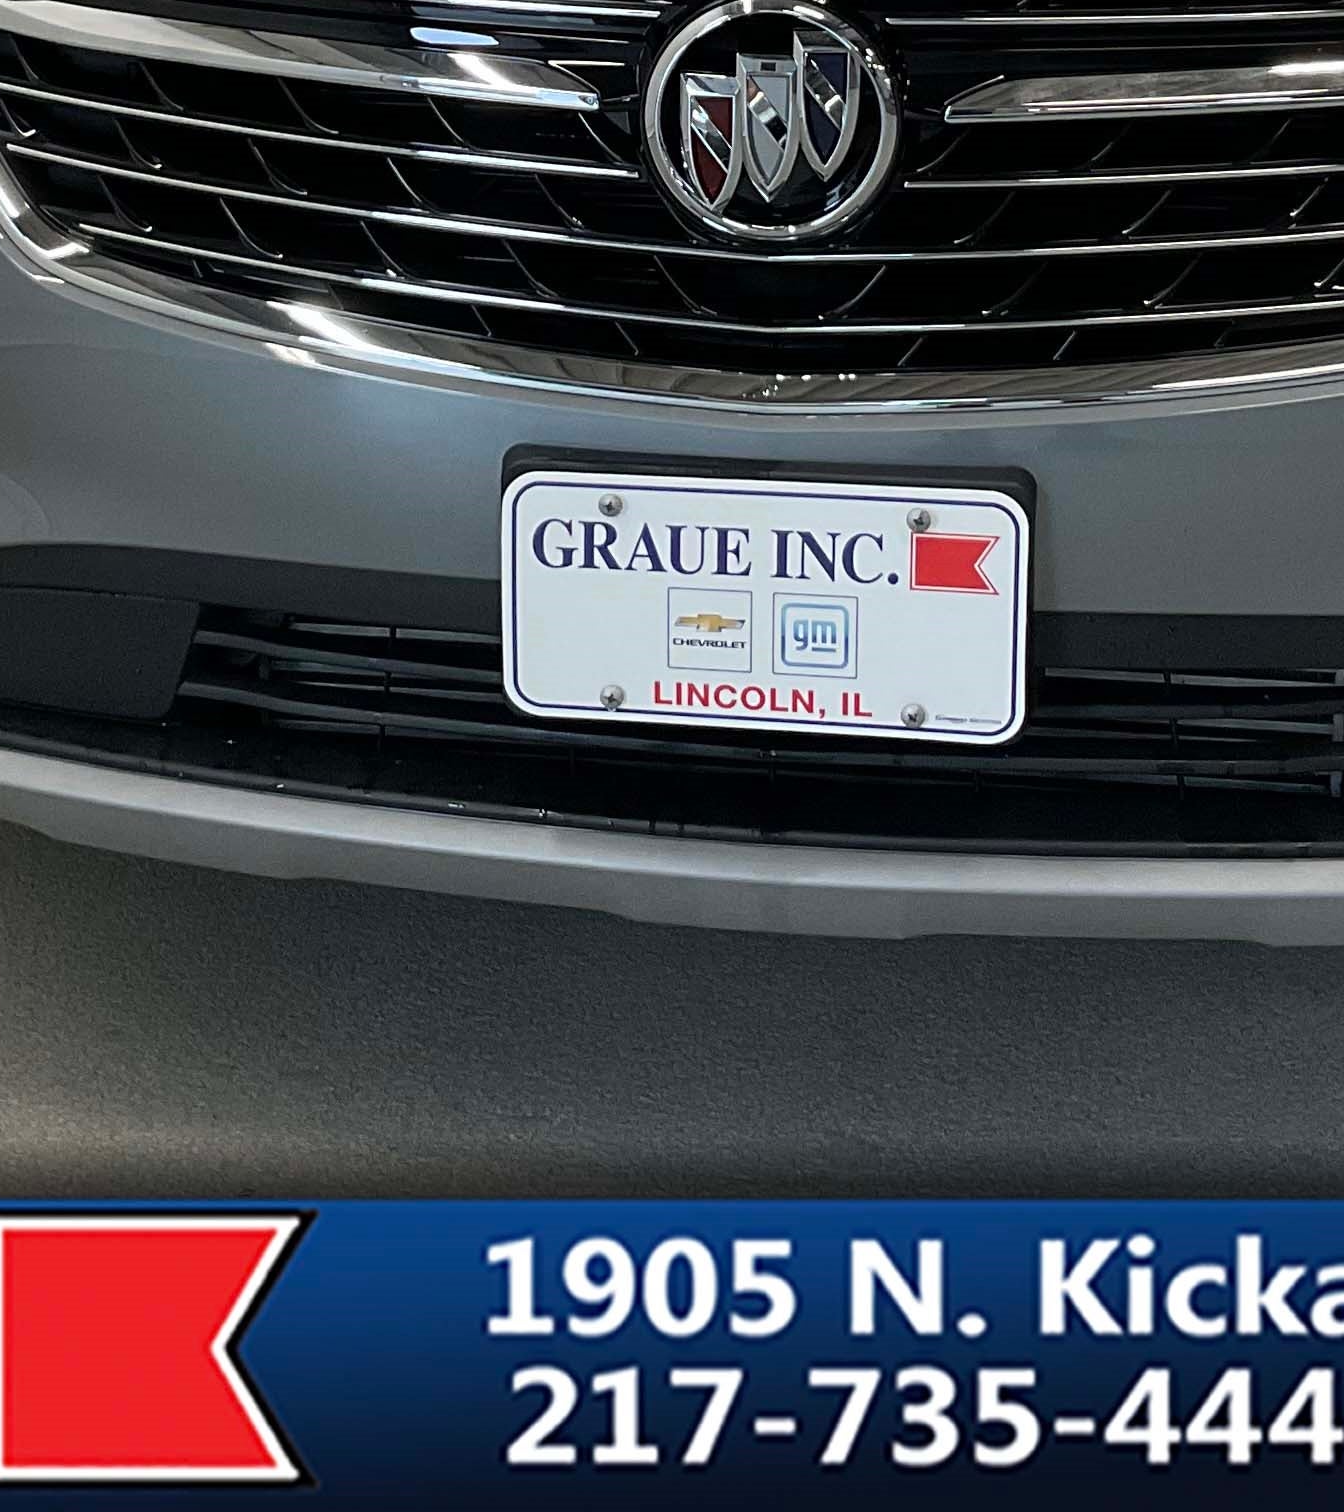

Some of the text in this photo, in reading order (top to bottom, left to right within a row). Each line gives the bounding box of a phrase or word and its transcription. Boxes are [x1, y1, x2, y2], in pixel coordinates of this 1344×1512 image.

[531, 519, 900, 586] GRAUE INC.
[672, 637, 747, 650] CHEVROLET
[793, 619, 837, 652] gm
[654, 680, 873, 719] LINCOLN, IL
